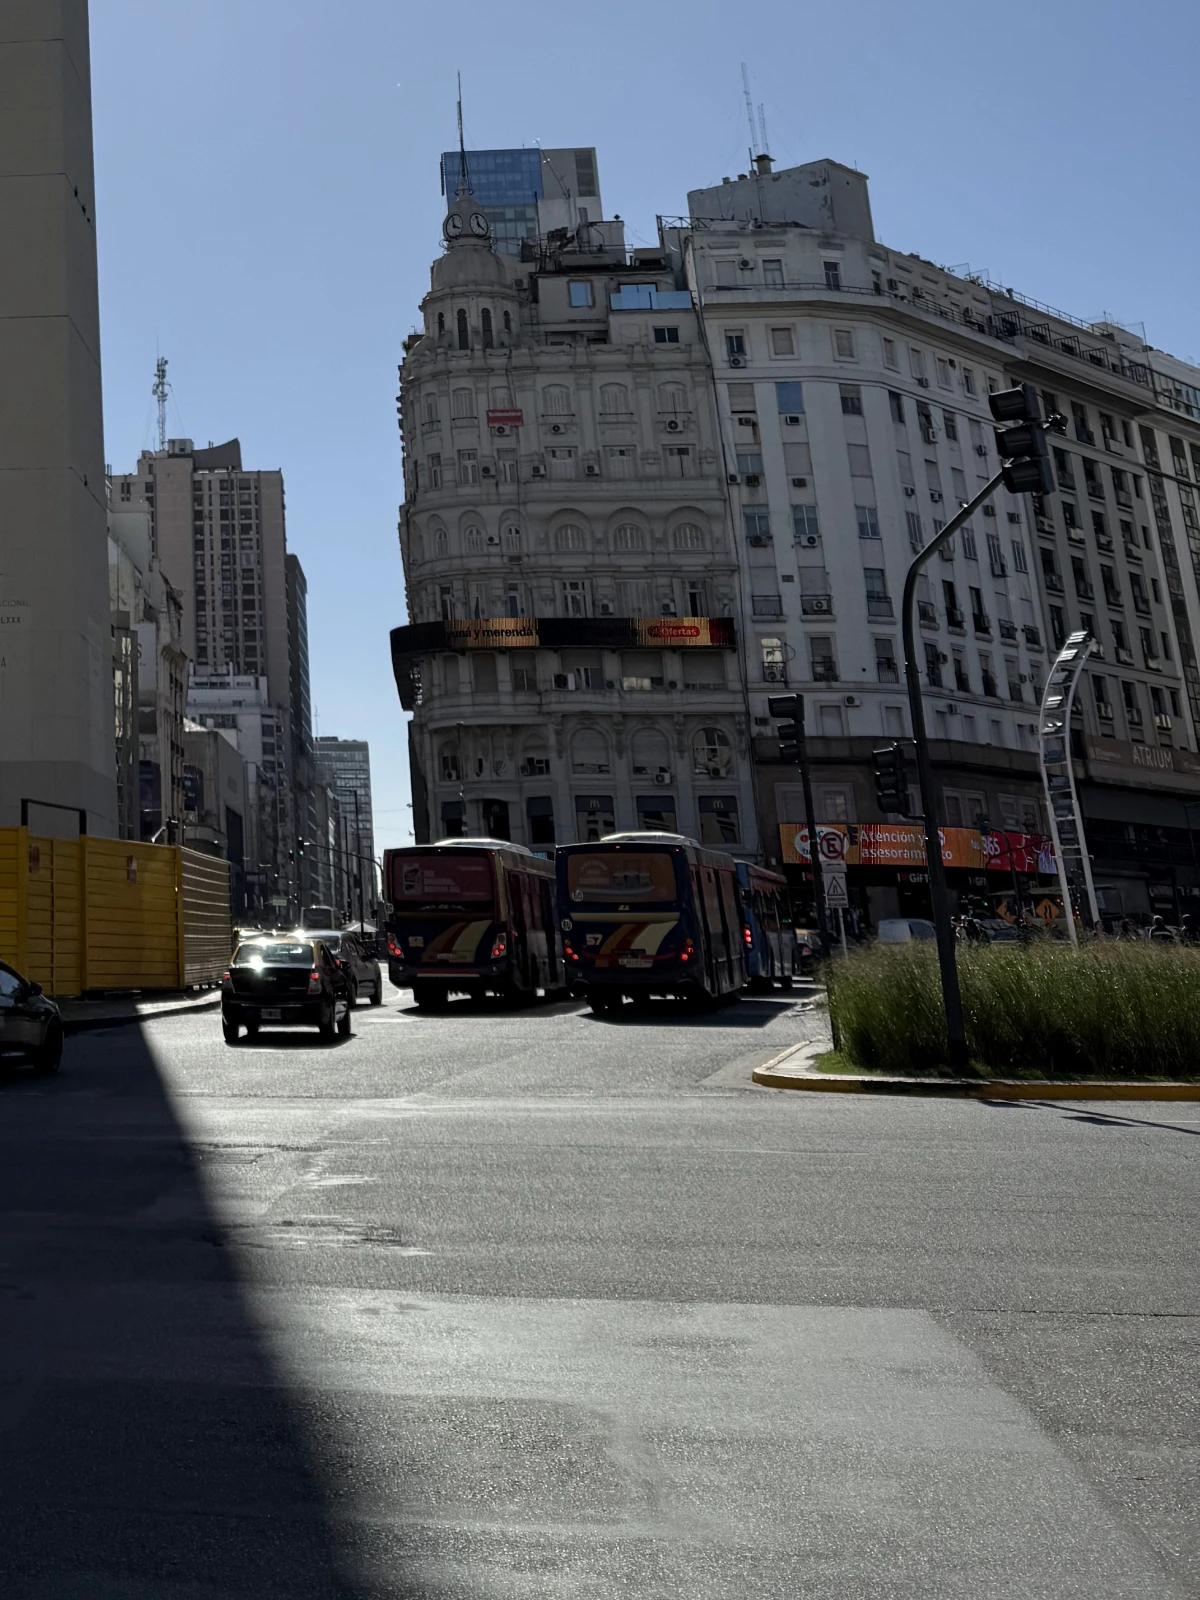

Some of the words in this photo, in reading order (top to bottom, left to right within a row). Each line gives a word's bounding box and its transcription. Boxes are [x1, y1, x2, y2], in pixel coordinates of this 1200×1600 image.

[1133, 745, 1175, 770] ATRIUM
[860, 829, 915, 843] Atención
[585, 933, 602, 945] 57
